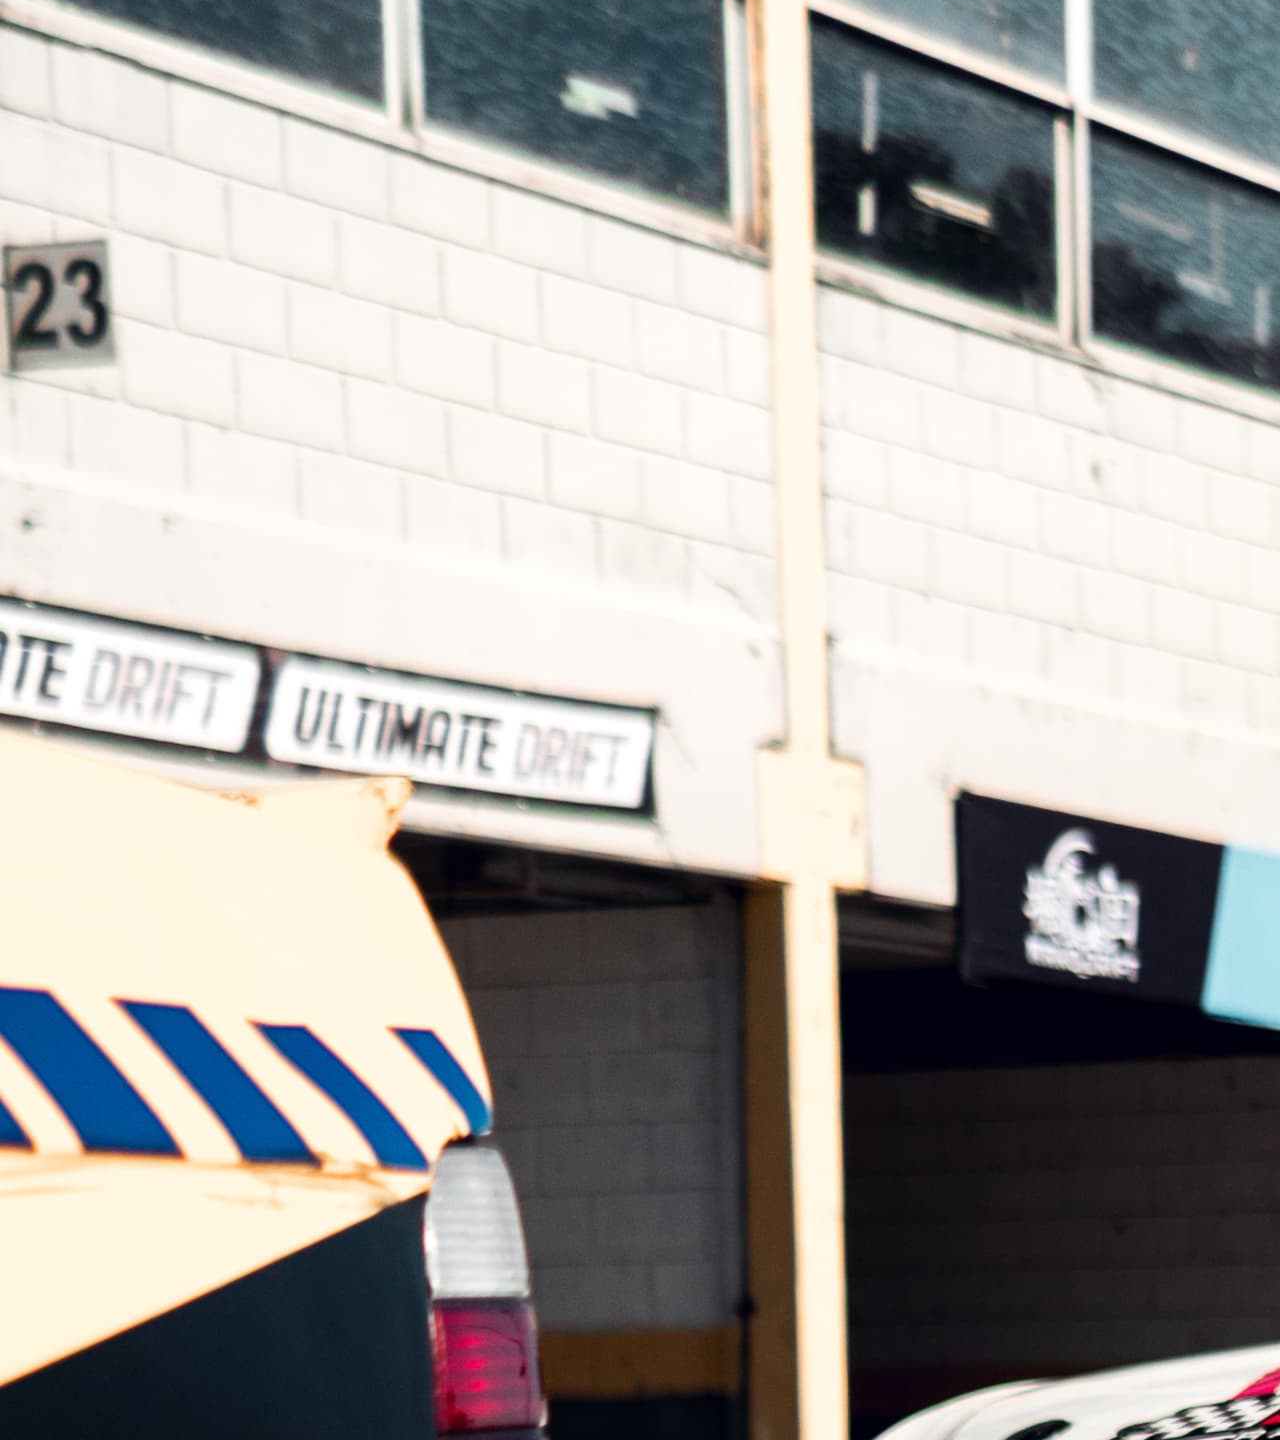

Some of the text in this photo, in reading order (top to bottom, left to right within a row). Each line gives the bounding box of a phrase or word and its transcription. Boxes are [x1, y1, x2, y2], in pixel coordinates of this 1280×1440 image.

[14, 259, 108, 350] 23
[83, 648, 233, 729] DRIFT
[294, 686, 632, 790] ULTIMATE DRIFT
